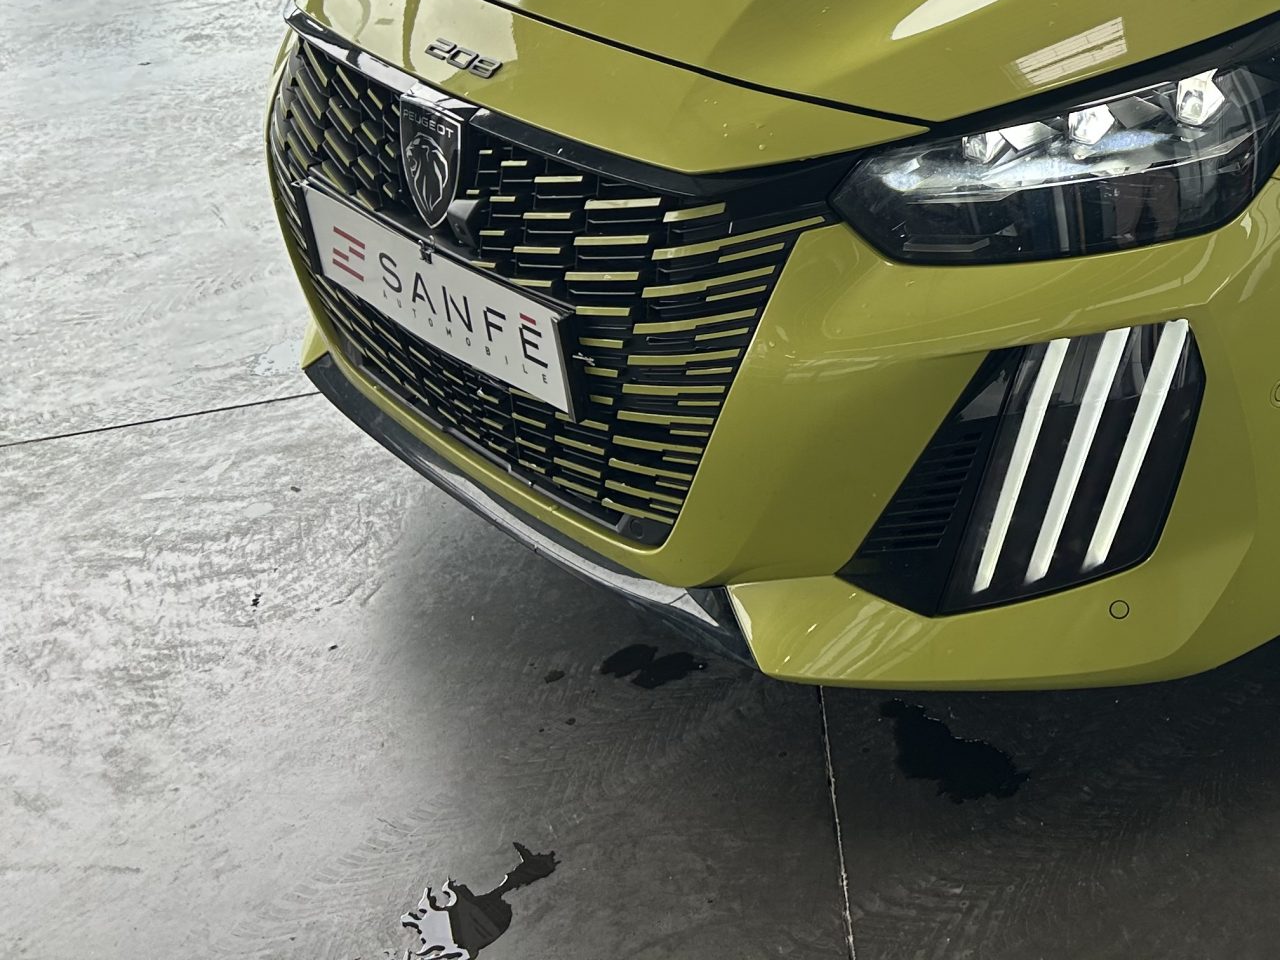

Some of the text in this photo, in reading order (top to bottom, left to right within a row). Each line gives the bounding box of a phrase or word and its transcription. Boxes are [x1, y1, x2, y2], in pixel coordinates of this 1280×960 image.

[424, 37, 504, 80] 208
[403, 109, 455, 139] PEUGEOT
[382, 290, 549, 385] AUTOMOBILE
